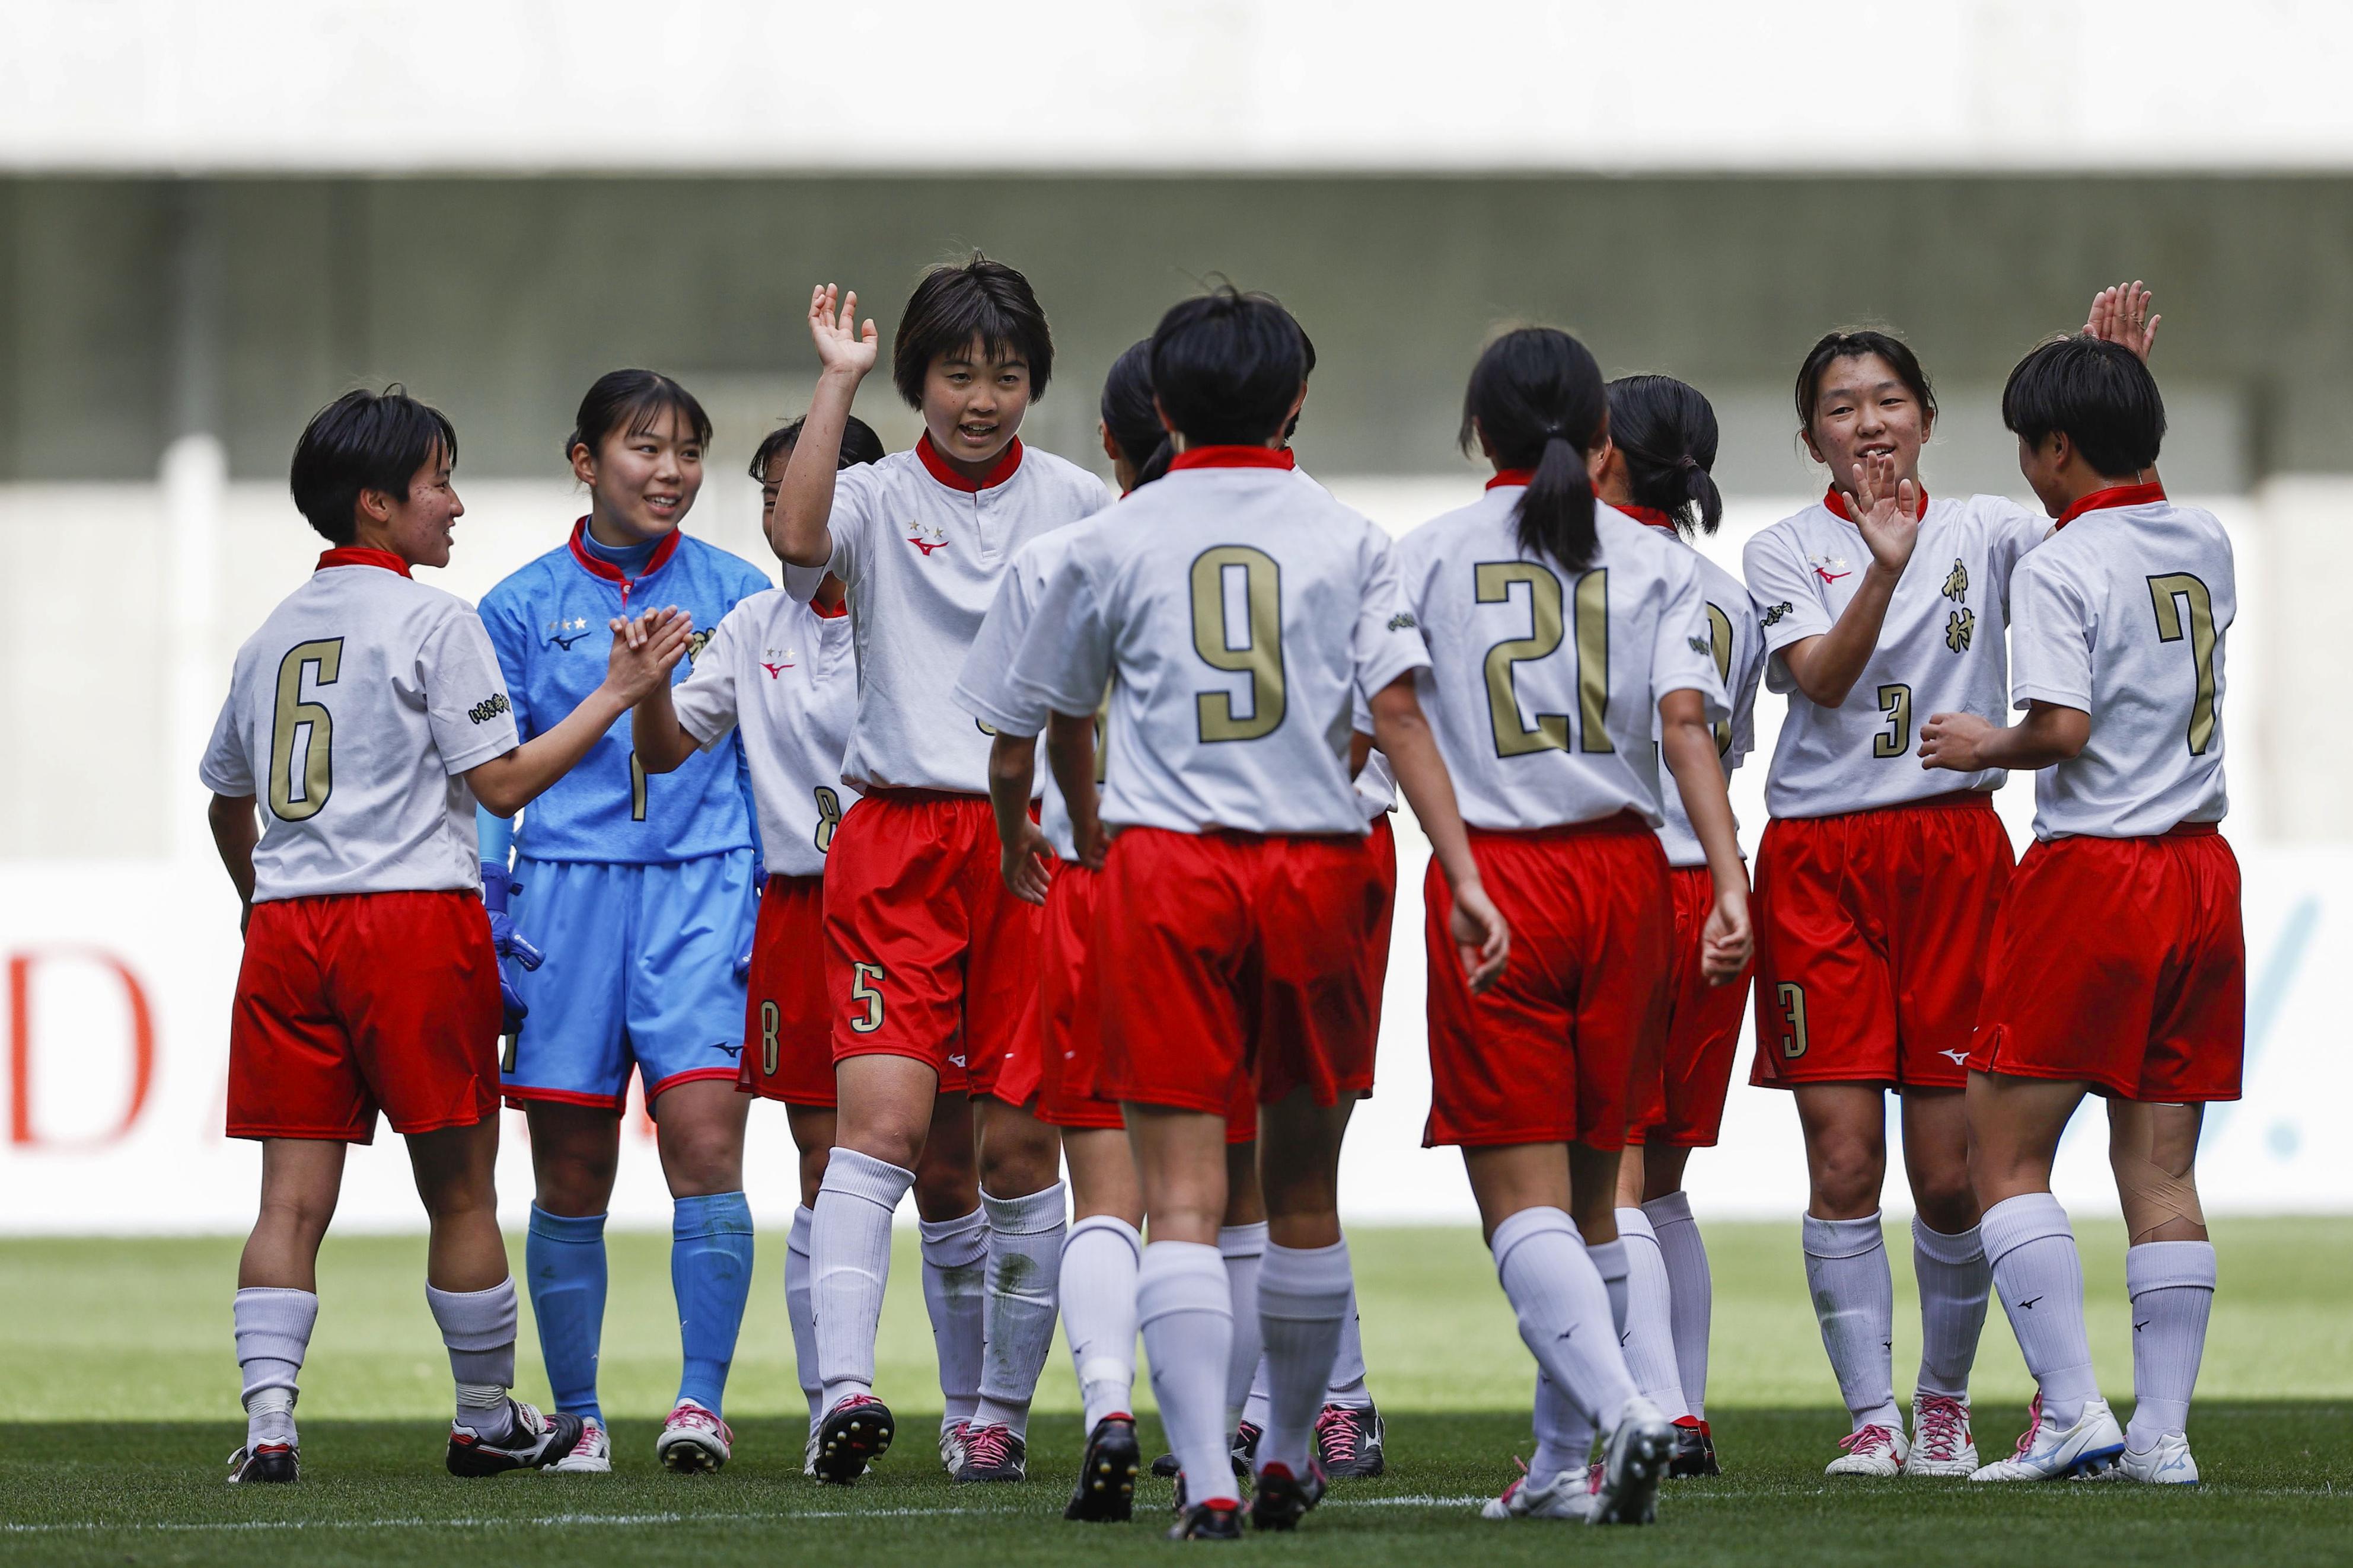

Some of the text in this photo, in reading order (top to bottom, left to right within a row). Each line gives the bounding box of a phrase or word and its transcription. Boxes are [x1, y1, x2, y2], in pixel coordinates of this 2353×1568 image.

[1190, 544, 1287, 743] 9
[1474, 561, 1615, 758] 21
[2145, 572, 2218, 756] 7
[269, 636, 345, 822] 6
[1873, 683, 1911, 758] 3
[814, 786, 841, 854] 8
[851, 962, 885, 1033] 5
[1777, 981, 1808, 1059] 3
[761, 999, 780, 1077] 8
